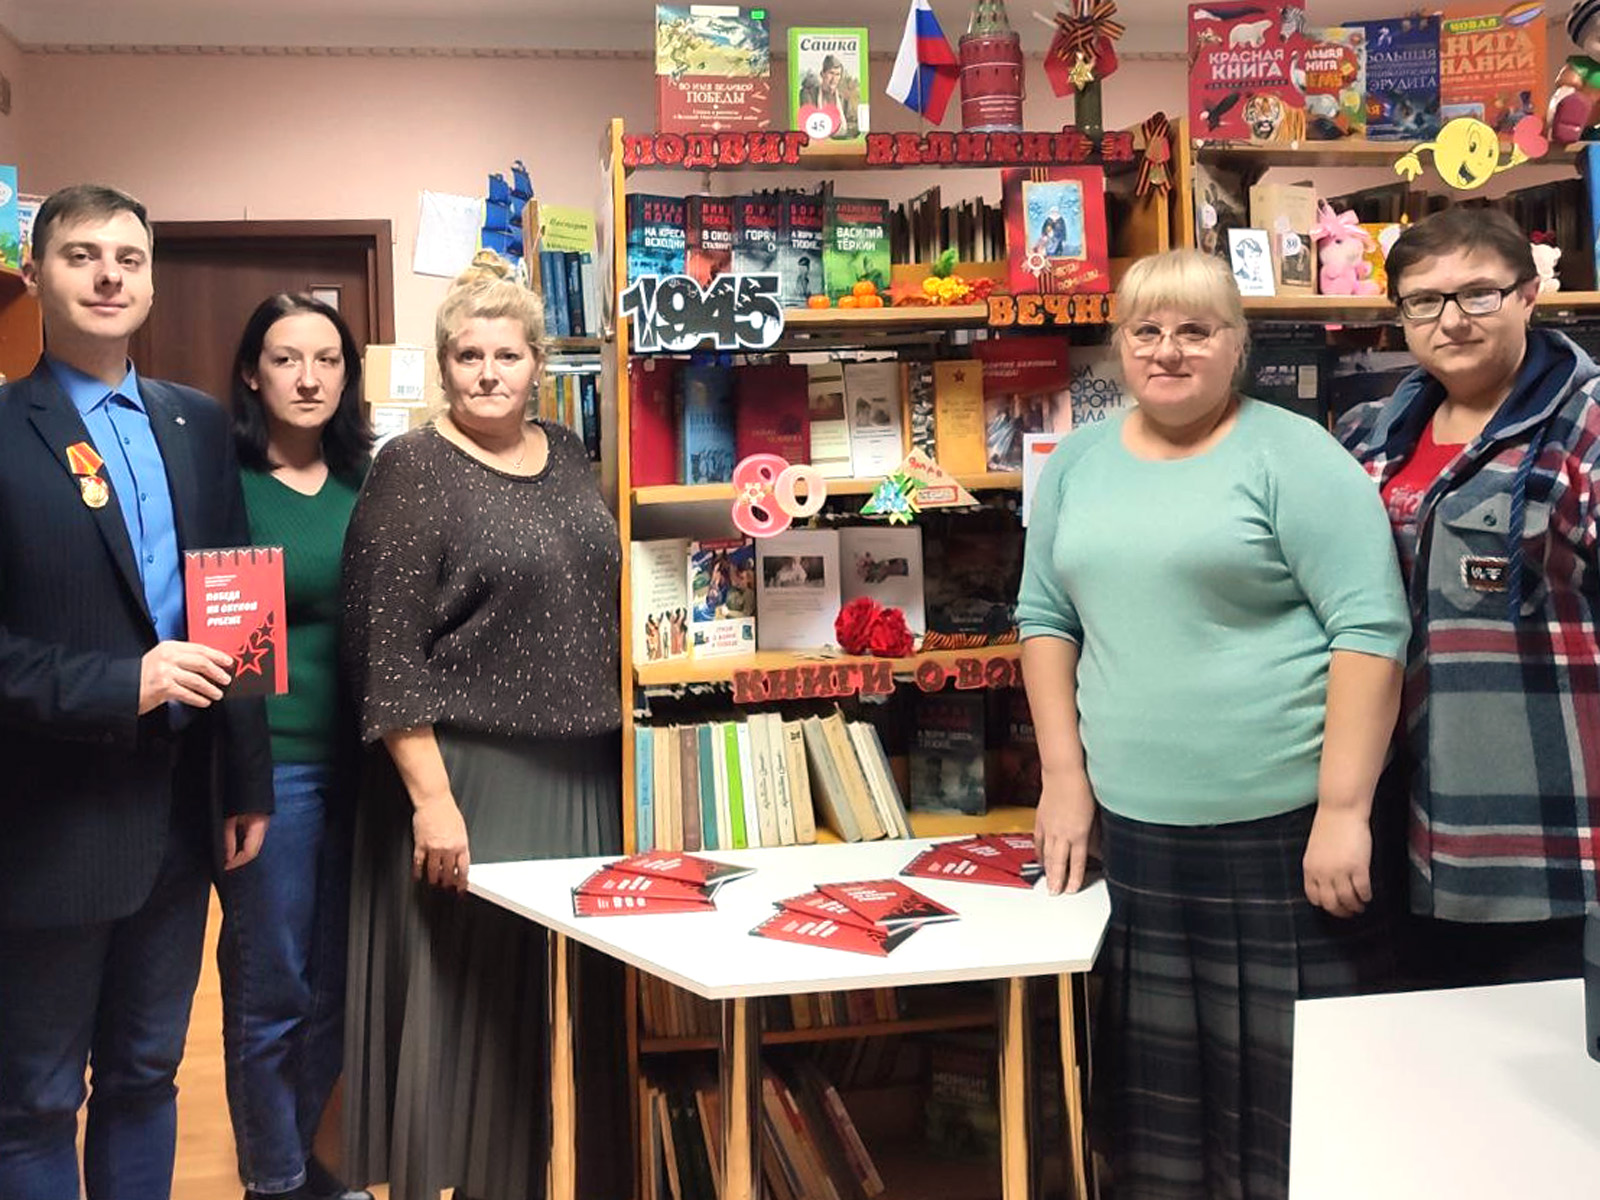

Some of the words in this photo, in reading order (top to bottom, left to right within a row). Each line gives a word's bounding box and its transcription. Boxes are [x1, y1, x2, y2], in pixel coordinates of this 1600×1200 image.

[1449, 17, 1498, 33] НОВАЯ
[800, 37, 859, 52] Сашка
[1208, 48, 1285, 65] КРАСНАЯ
[1211, 61, 1284, 80] КНИГА
[686, 90, 745, 104] ПОБЕДЫ
[622, 131, 809, 169] ПОДВИГ
[865, 124, 1093, 165] ВЕЛИКИЙ
[645, 226, 656, 237] НА
[702, 230, 710, 241] В
[836, 226, 884, 239] ВАСИЛИЙ
[618, 272, 786, 353] 1945
[731, 453, 828, 538] 80
[205, 590, 241, 602] ПОБЕДА
[733, 660, 896, 704] КНИГИ
[915, 660, 945, 692] О
